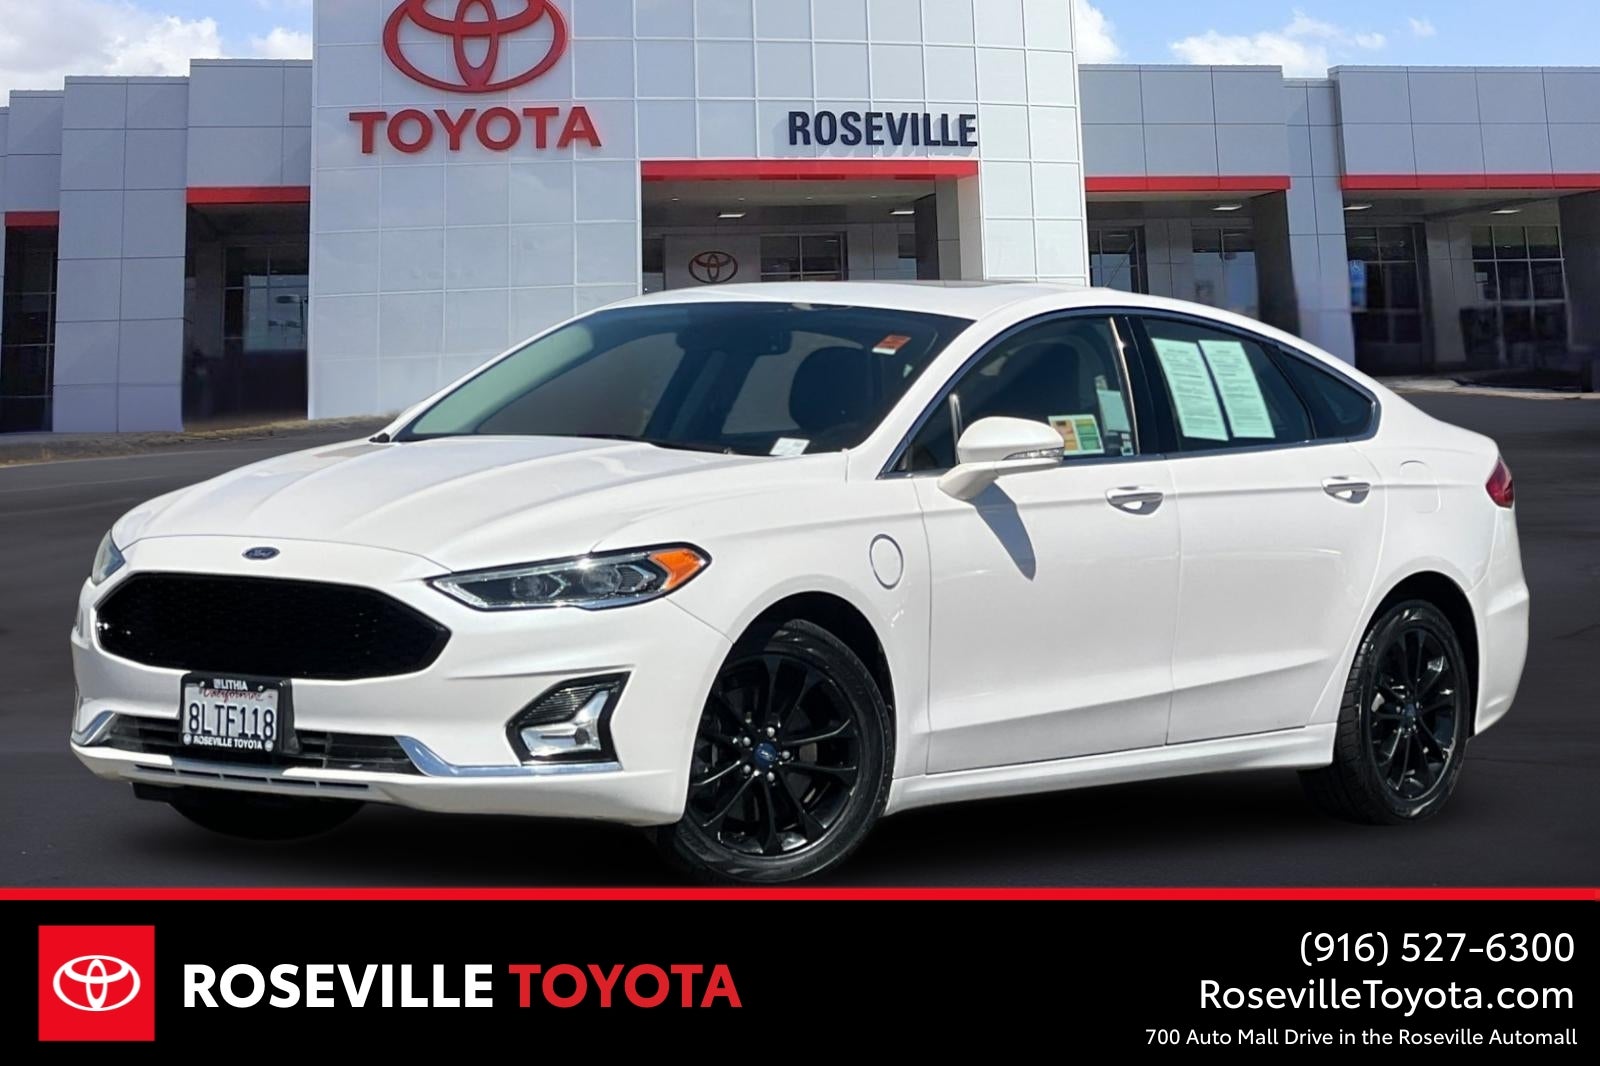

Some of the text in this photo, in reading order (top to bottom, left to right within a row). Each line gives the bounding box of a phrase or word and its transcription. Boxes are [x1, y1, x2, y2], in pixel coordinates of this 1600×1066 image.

[350, 106, 602, 154] TOYOTA
[788, 111, 978, 147] ROSEVILLE
[221, 679, 248, 691] LITHIA
[189, 702, 275, 740] 8LTF118
[193, 736, 263, 750] ROSEVILLE TOYOTA
